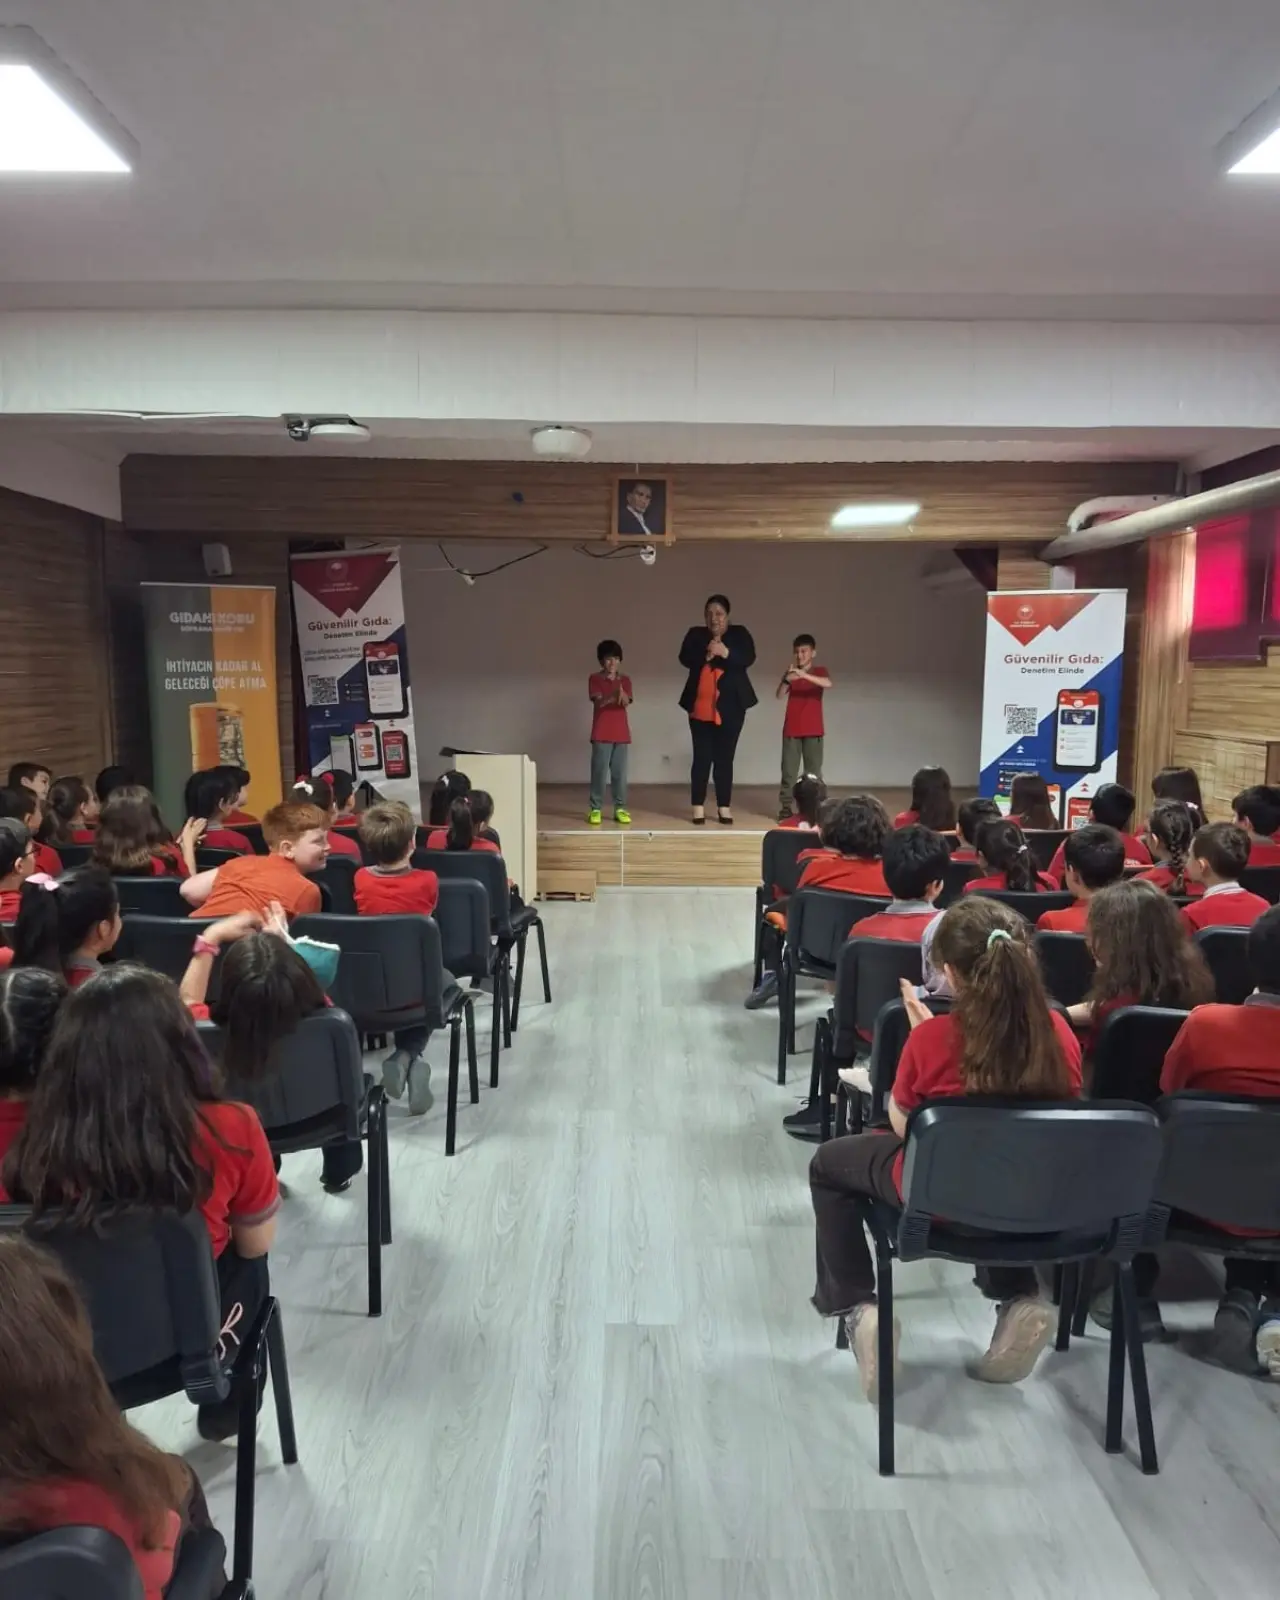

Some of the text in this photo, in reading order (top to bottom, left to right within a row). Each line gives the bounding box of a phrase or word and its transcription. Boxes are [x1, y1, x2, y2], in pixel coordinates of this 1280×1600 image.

[307, 616, 393, 631] Güvenilir Gıda:
[165, 657, 213, 673] İHTİYACIN
[1004, 653, 1104, 664] Güvenilir Gıda:
[1020, 666, 1085, 675] Denetim Elinde
[164, 675, 210, 691] GELECEĞİ
[239, 677, 267, 690] ATMA
